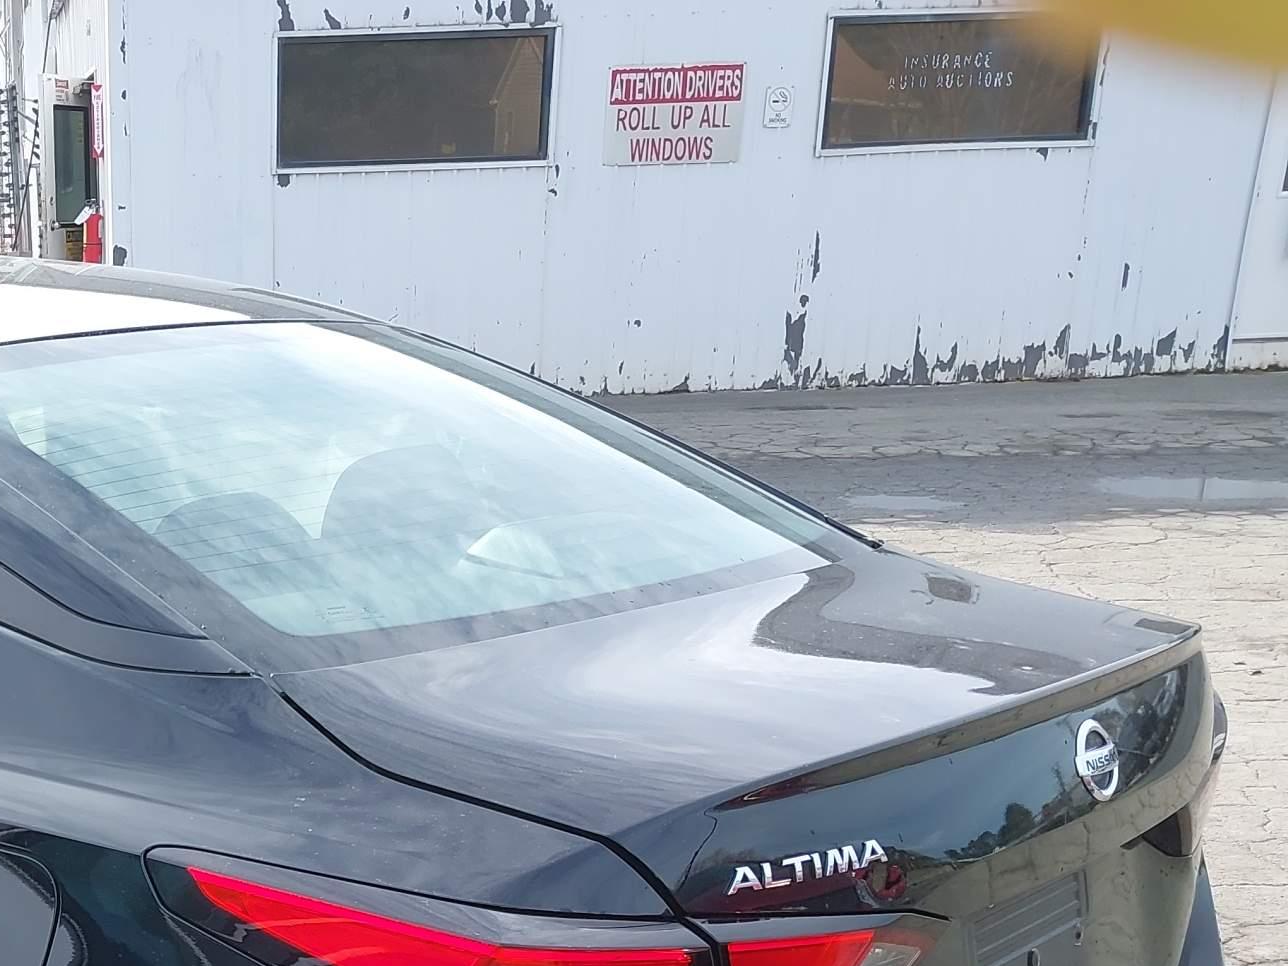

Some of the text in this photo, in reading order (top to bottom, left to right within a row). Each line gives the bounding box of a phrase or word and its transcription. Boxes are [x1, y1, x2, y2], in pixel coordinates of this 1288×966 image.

[904, 51, 993, 70] INSURANCE
[611, 68, 743, 103] ATTENTION DRIVERS
[887, 71, 1013, 91] AUTO AUCTIONS
[616, 104, 731, 132] ROLL UP ALL
[629, 136, 713, 163] WINDOWS
[726, 838, 889, 896] ALTIMA
